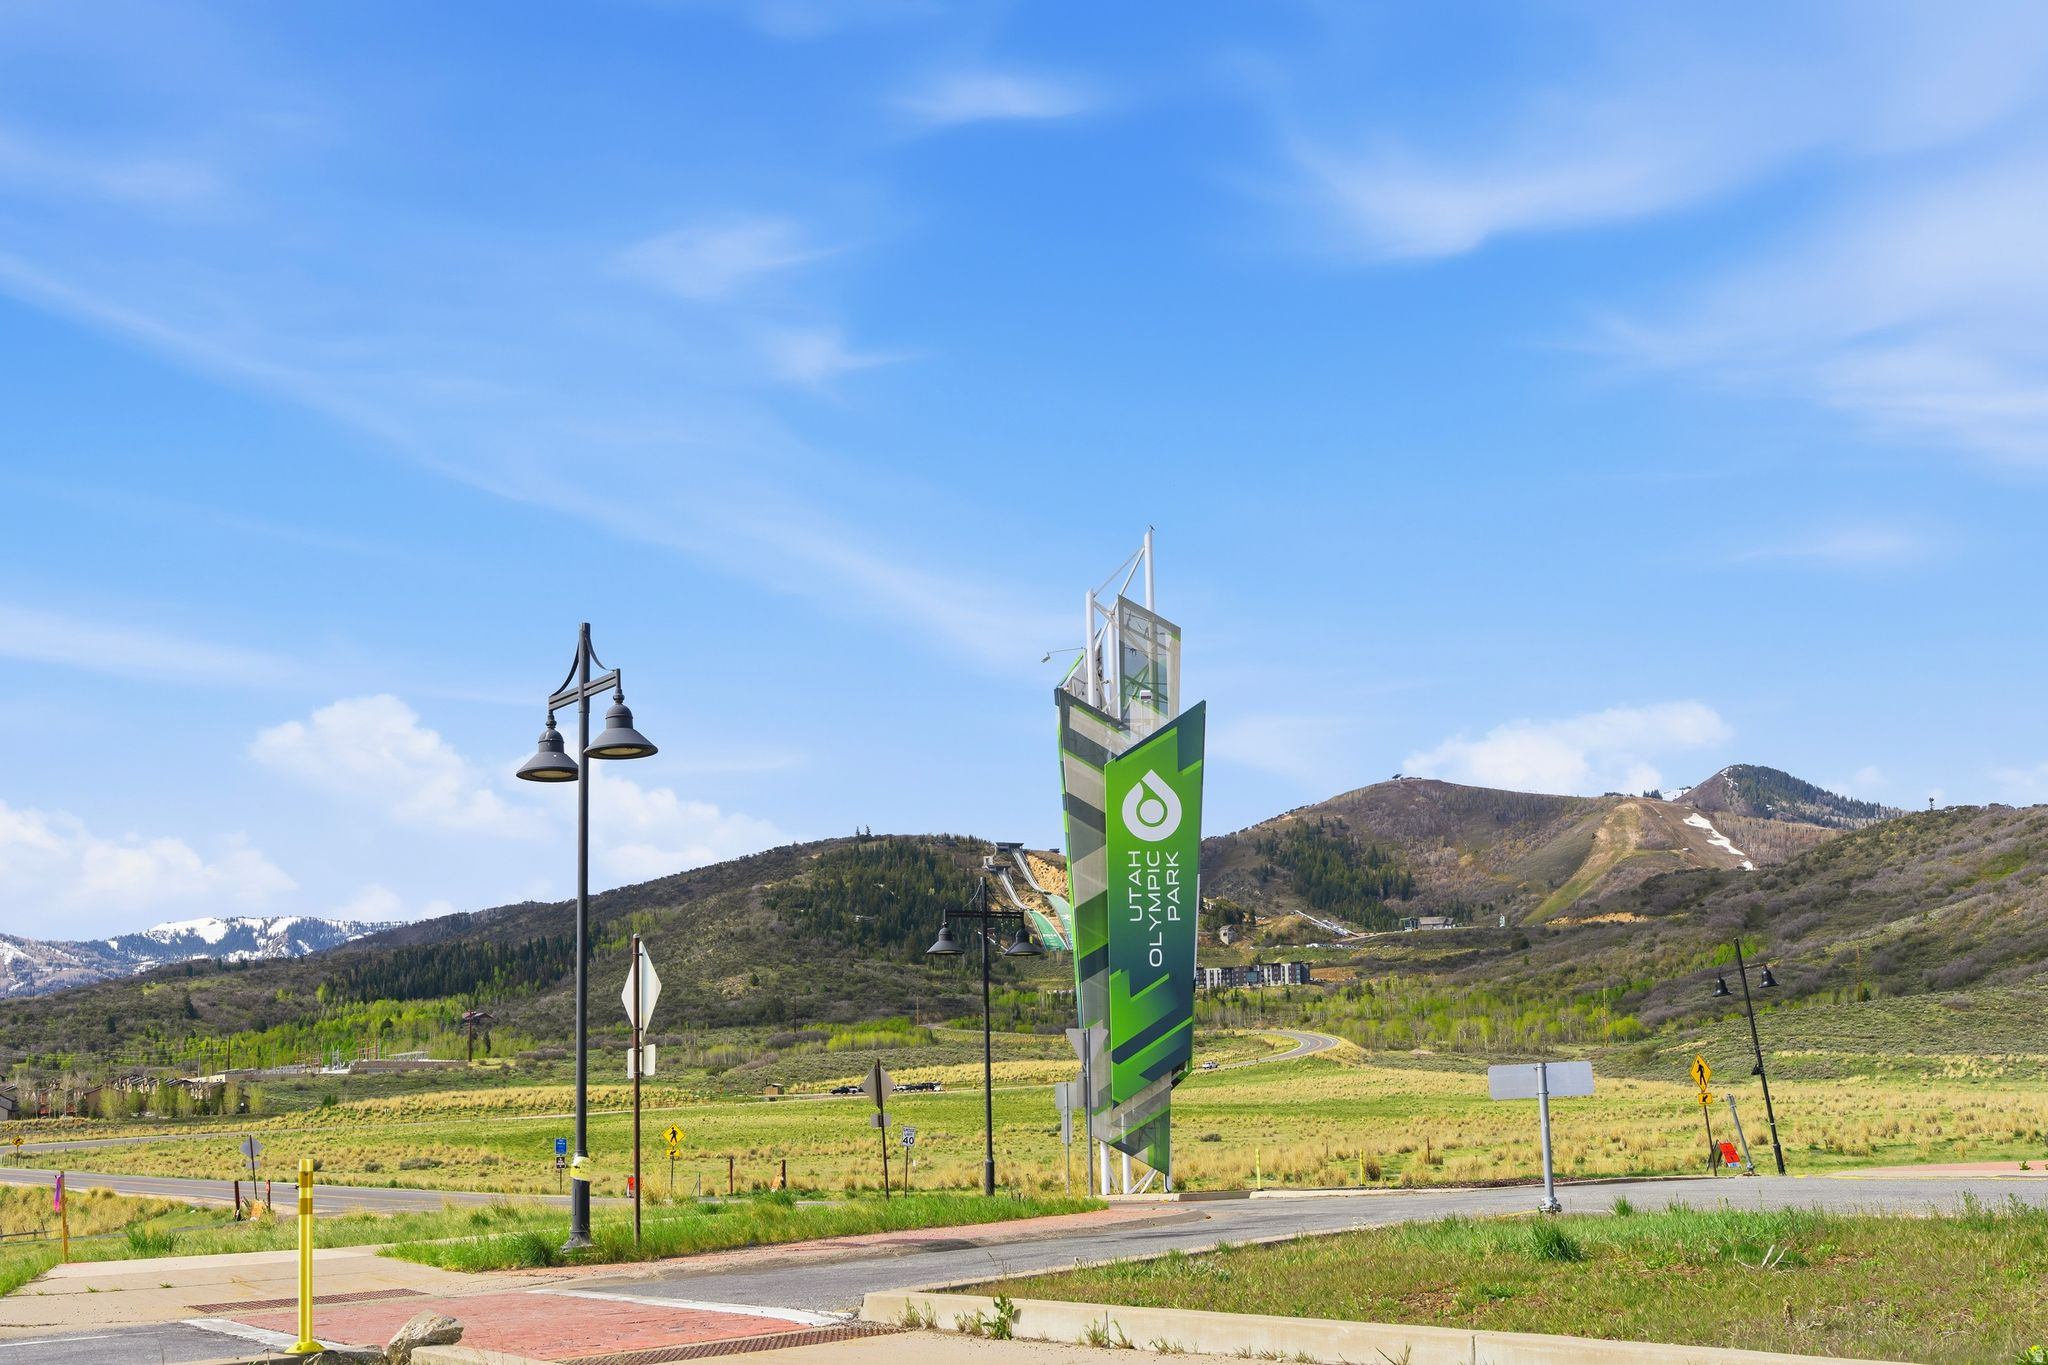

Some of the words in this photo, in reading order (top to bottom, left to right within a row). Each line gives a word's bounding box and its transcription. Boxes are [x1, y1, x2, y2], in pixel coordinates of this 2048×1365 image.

[1128, 851, 1143, 921] UTAH
[1146, 851, 1163, 967] OLYMPIC
[1165, 851, 1180, 921] PARK
[903, 1136, 914, 1145] 40
